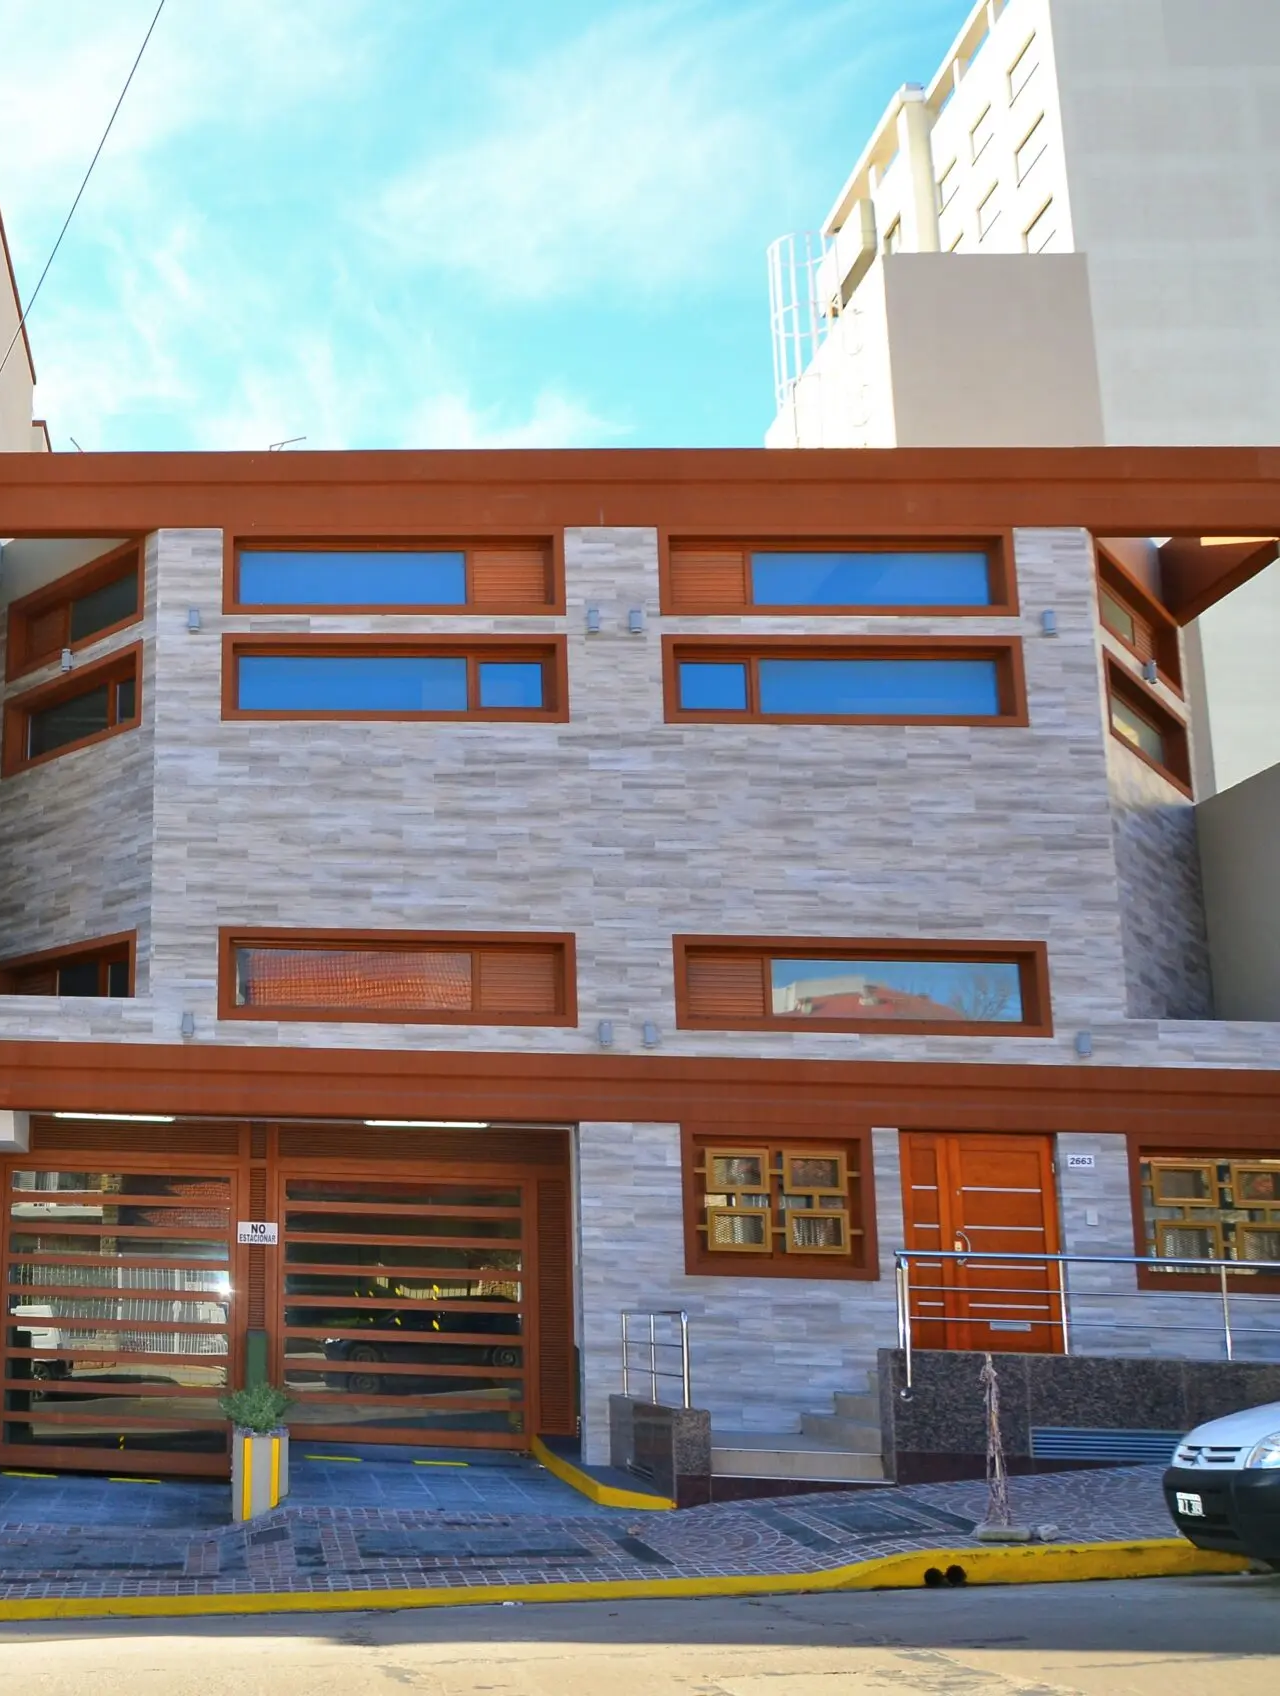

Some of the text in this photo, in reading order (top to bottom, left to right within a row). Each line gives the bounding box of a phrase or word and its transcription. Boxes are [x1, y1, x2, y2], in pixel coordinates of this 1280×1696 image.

[1070, 1157, 1093, 1165] 2663
[251, 1223, 266, 1234] NO
[239, 1233, 276, 1242] ESTACIONAR
